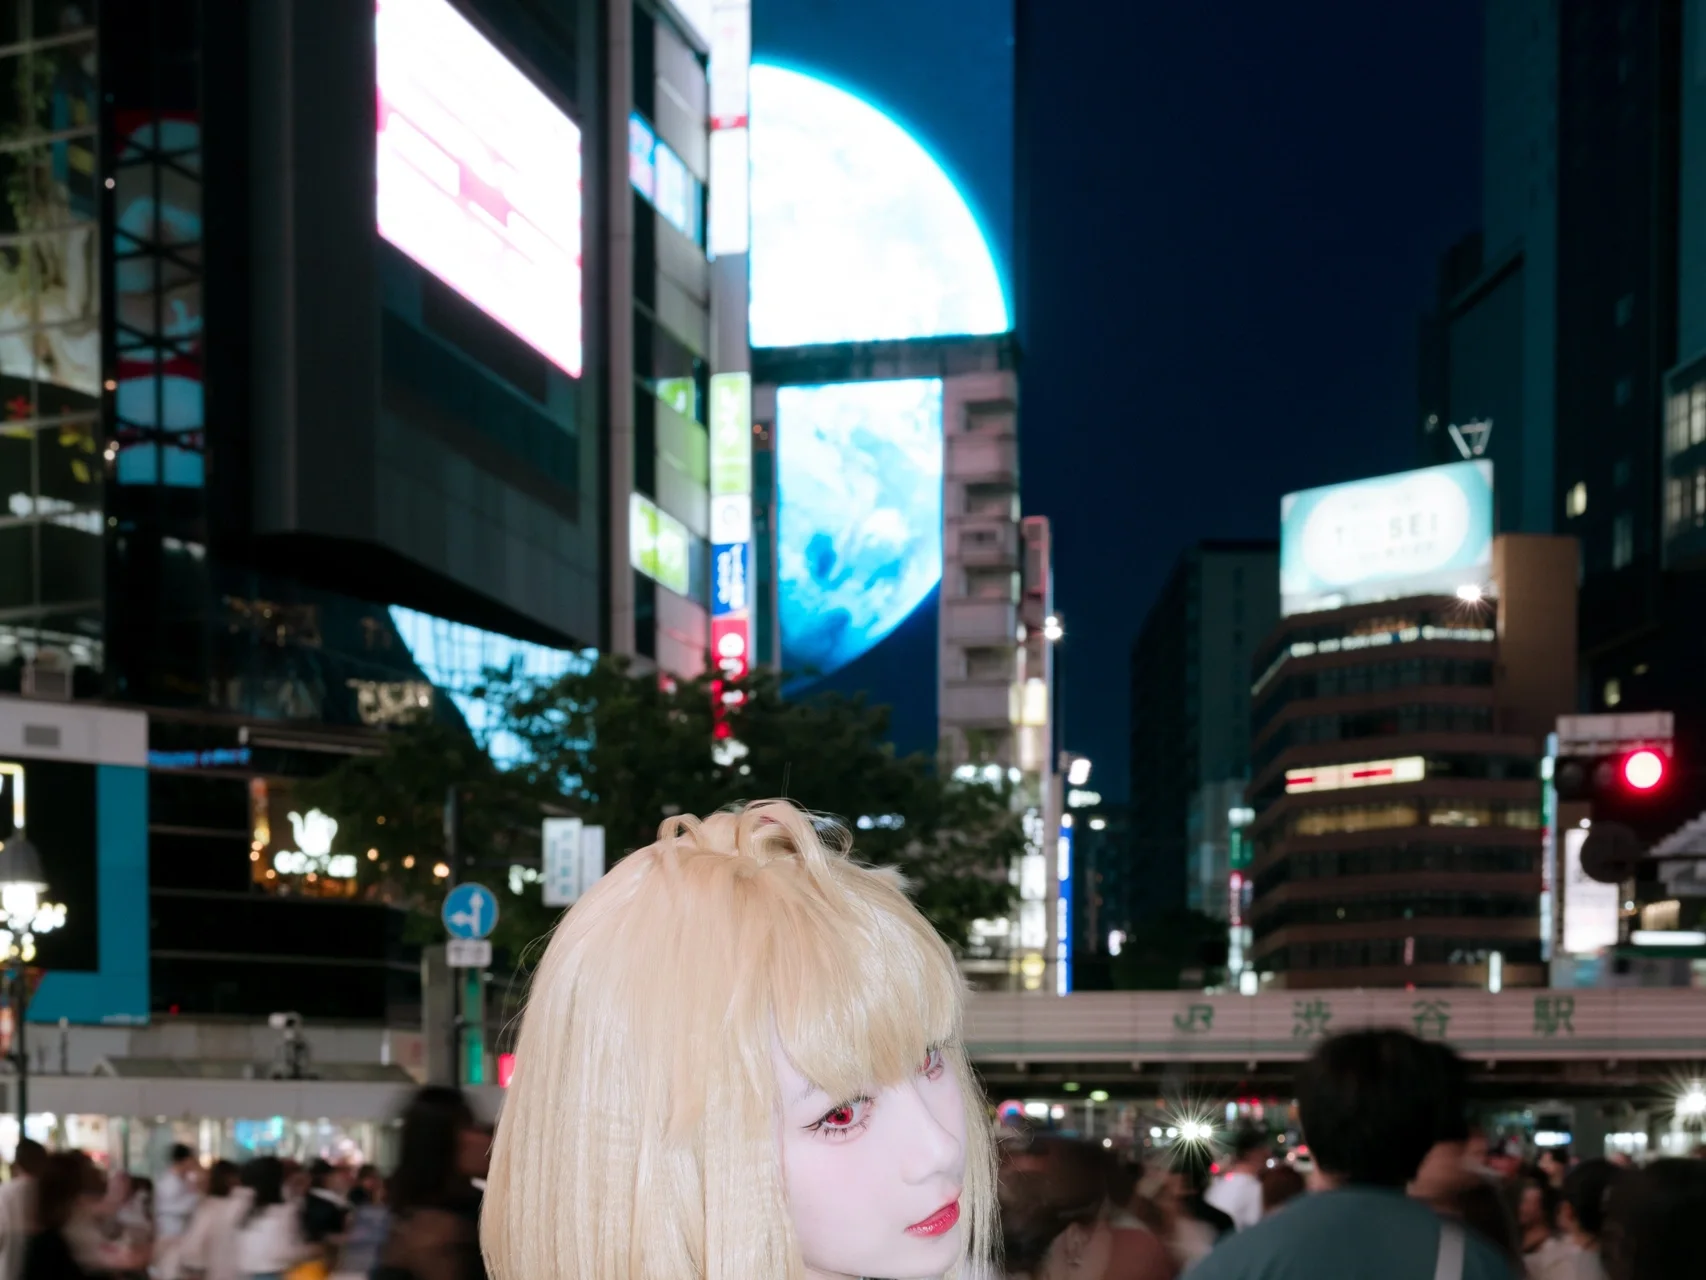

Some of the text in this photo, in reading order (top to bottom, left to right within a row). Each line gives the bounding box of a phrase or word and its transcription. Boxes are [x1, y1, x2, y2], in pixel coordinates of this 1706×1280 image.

[1172, 995, 1575, 1039] JR 渋谷駅
